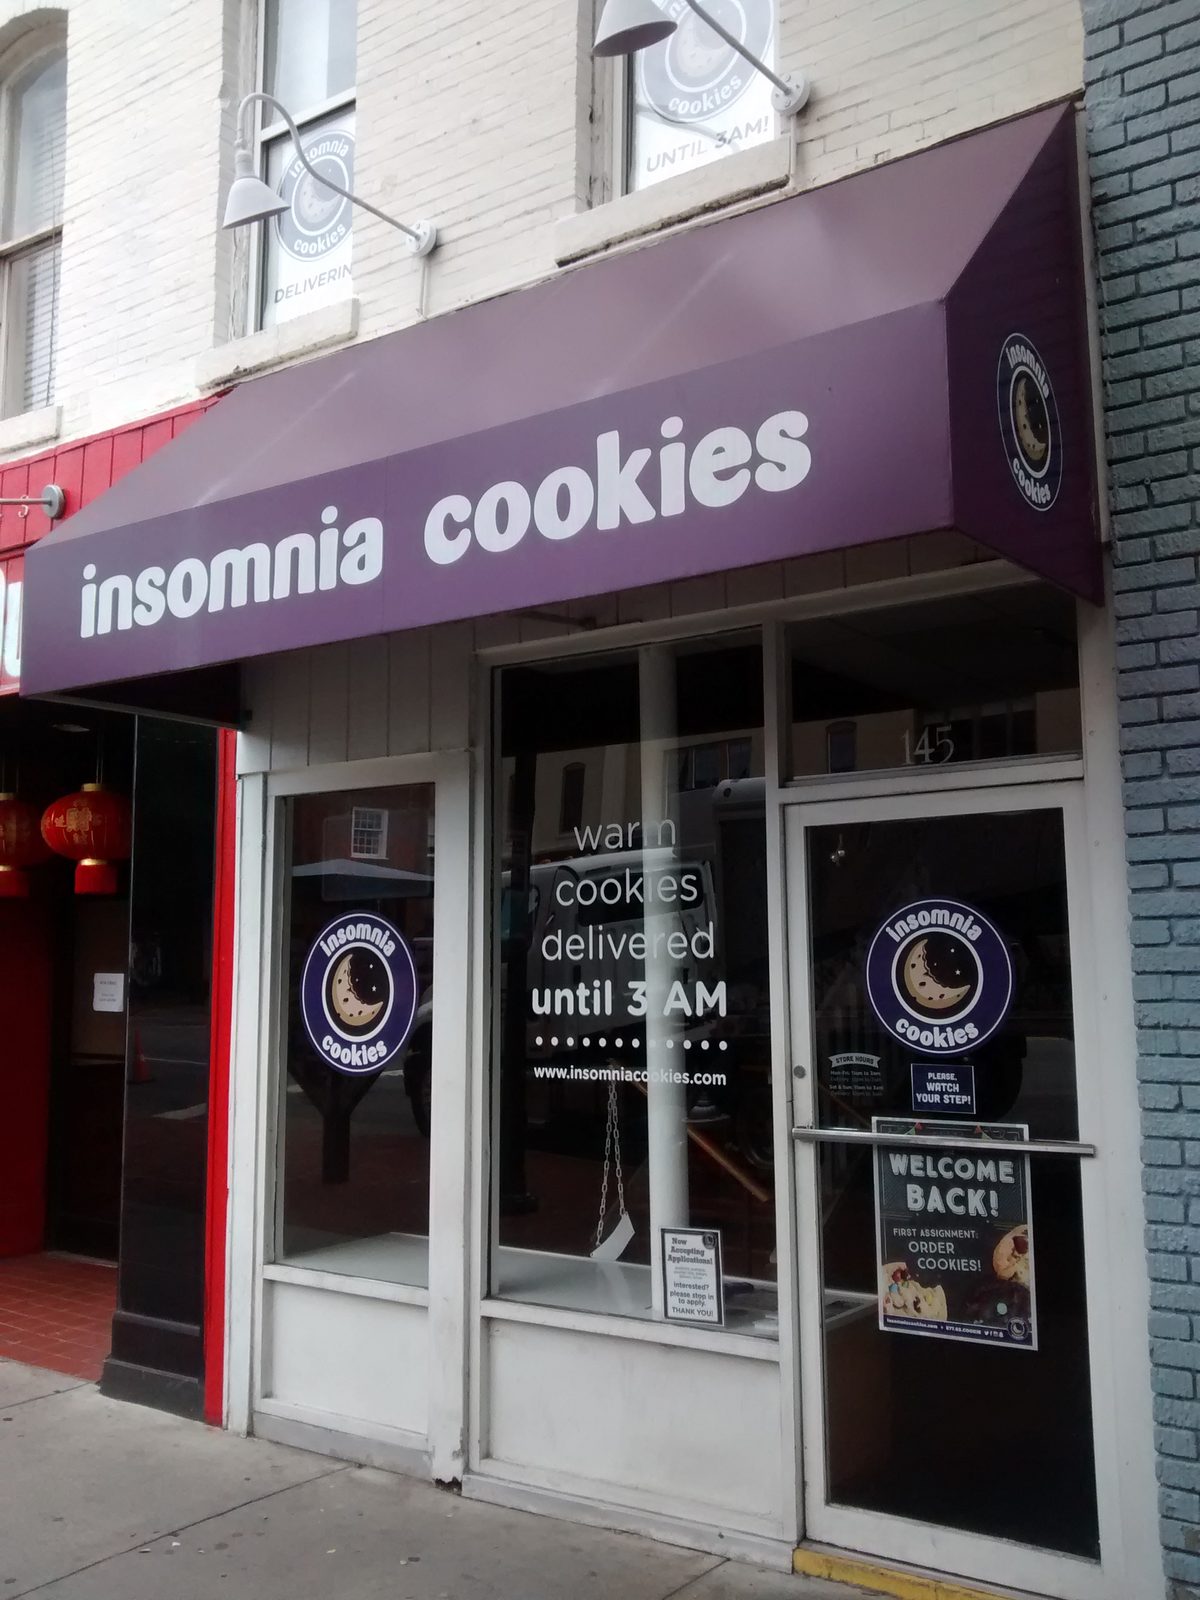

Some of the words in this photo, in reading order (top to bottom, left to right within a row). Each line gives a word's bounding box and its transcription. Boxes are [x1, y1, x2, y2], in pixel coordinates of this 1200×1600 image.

[668, 74, 742, 115] cookies
[646, 140, 708, 172] UNTIL
[715, 116, 769, 149] 3AM!
[293, 223, 346, 254] cookies
[1005, 344, 1050, 398] insomnia
[1013, 458, 1051, 504] cookies
[80, 505, 384, 638] insomnia
[424, 410, 812, 565] cookies
[901, 725, 955, 765] 145
[574, 818, 676, 851] warm
[556, 868, 698, 906] cookies
[320, 923, 396, 957] insomnia
[542, 921, 715, 961] delivered
[886, 909, 982, 943] insomnia
[532, 980, 612, 1016] until
[627, 981, 649, 1017] 3
[663, 981, 727, 1017] AM
[896, 1018, 979, 1048] cookies
[322, 1035, 388, 1066] cookies
[835, 1055, 854, 1064] STORE
[855, 1055, 875, 1065] HOURS
[534, 1065, 727, 1086] www.insomniacookies.com
[926, 1082, 960, 1093] WATCH
[916, 1093, 941, 1104] YOUR
[943, 1094, 971, 1105] STEP!
[889, 1153, 1015, 1184] WELCOME
[906, 1184, 999, 1218] BACK!
[672, 1237, 687, 1245] Now
[893, 1228, 917, 1237] FIRST
[920, 1228, 979, 1239] ASSIGNMENT:
[908, 1241, 955, 1255] ORDER
[670, 1246, 705, 1257] Accepting
[917, 1257, 982, 1272] COOKIES!
[669, 1290, 690, 1298] please
[692, 1292, 706, 1300] stop
[672, 1306, 695, 1315] THANK
[697, 1309, 713, 1317] YOU!
